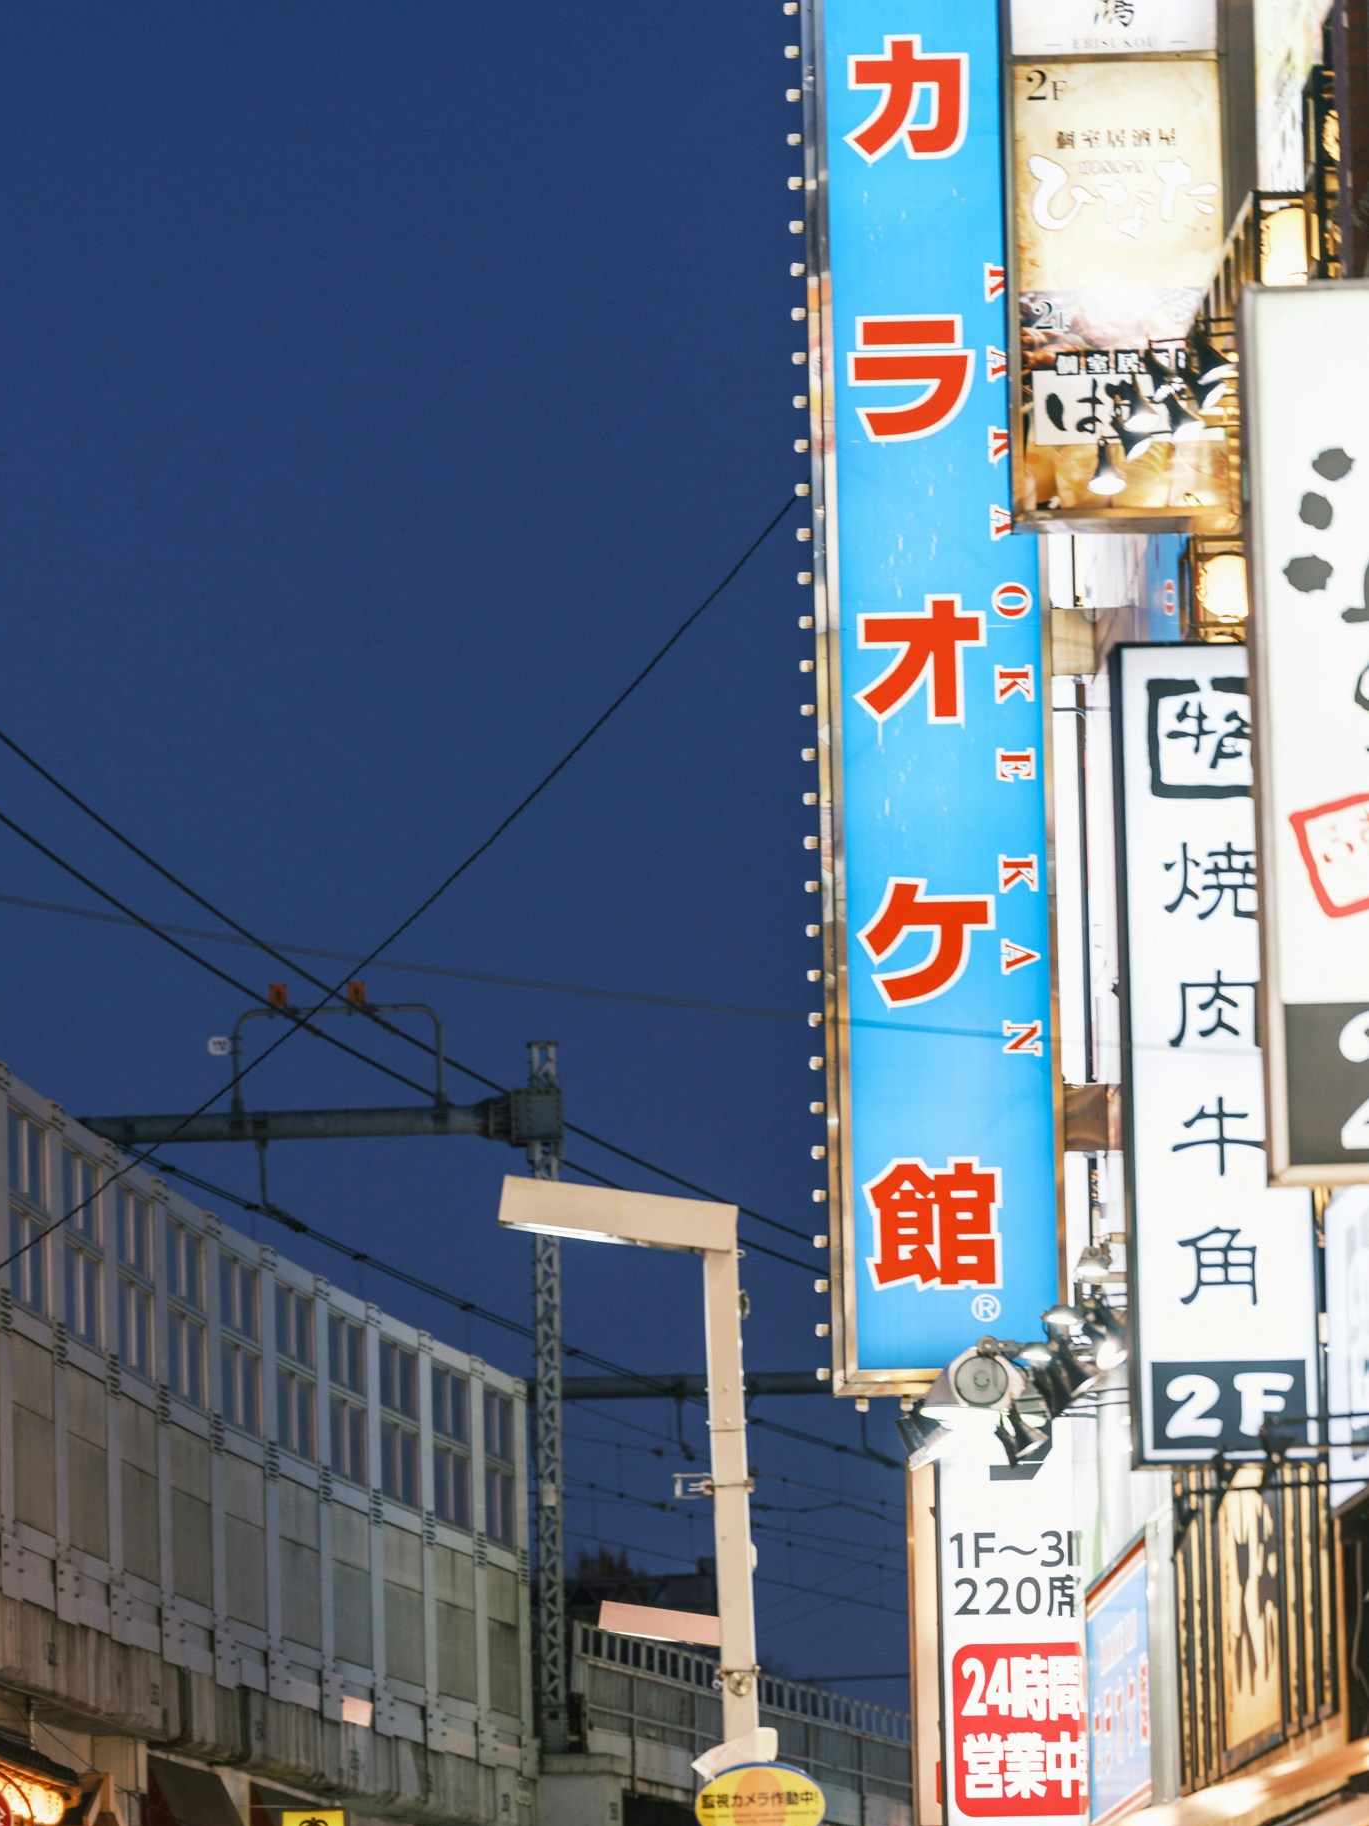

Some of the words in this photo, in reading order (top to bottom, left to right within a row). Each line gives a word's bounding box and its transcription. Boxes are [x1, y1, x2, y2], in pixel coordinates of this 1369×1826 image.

[1026, 69, 1067, 101] 2F
[1056, 128, 1177, 149] 個室居酒屋
[1027, 155, 1219, 240] ひなた
[844, 34, 1002, 1290] カラオケ館
[1163, 842, 1265, 1305] 焼肉牛角
[1165, 1372, 1295, 1439] 2F
[953, 1576, 1080, 1617] 220席
[960, 1655, 1088, 1721] 24時間
[962, 1731, 1088, 1799] 営業中
